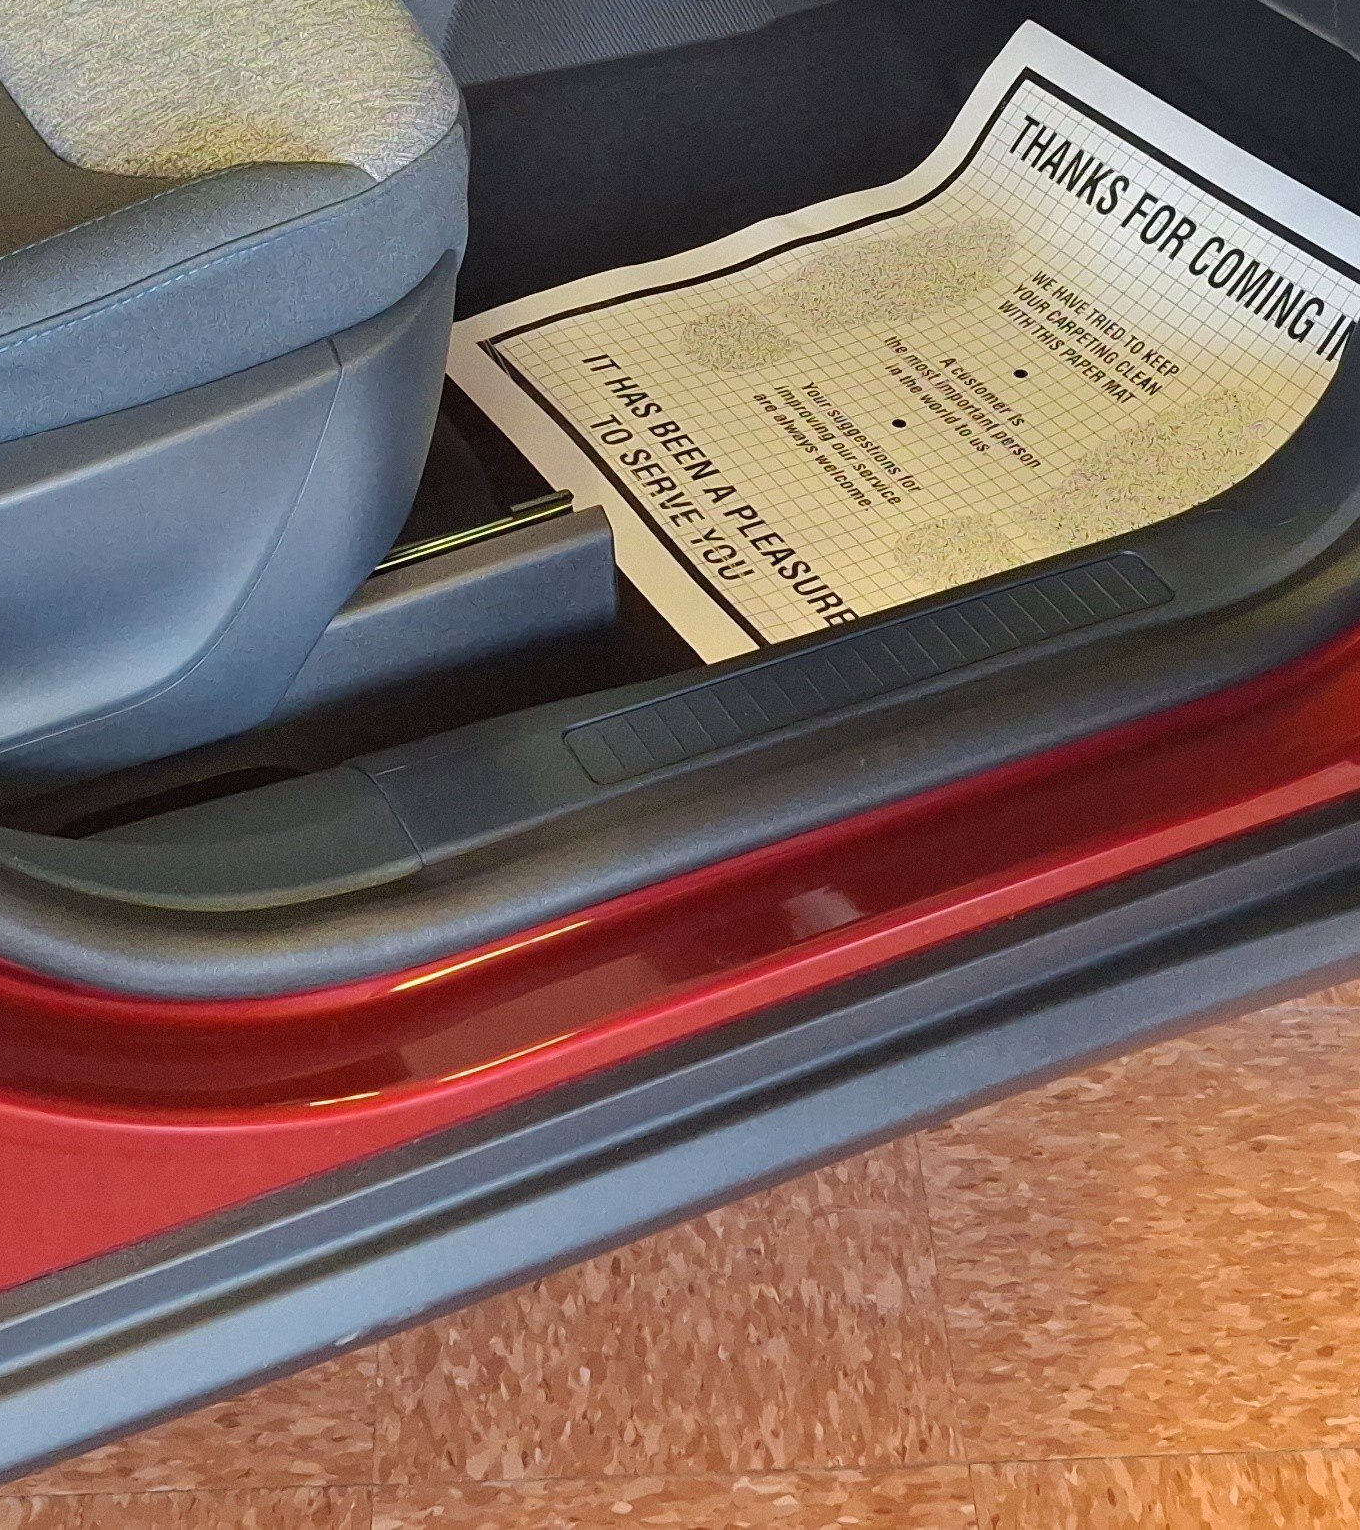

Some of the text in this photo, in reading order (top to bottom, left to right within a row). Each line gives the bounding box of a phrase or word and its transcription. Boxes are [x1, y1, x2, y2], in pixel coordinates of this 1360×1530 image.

[1009, 115, 1130, 215] THANKS
[1121, 192, 1197, 260] FOR
[1189, 236, 1325, 343] COMING
[998, 300, 1137, 403] WITH THIS PAPER MAT
[1013, 283, 1163, 396] YOUR CARPETING CLEAN
[1032, 271, 1180, 377] WE HAVE TRIED TO KEEP
[754, 393, 777, 412] are
[774, 414, 818, 453] always
[774, 385, 901, 505] improving our service
[802, 382, 922, 493] Your suggestions for
[884, 336, 1041, 469] the most important person
[885, 363, 989, 452] in the world to us
[939, 358, 1025, 427] A customer is
[582, 354, 859, 627] IT HAS BEEN A PLEASURE
[590, 415, 755, 581] TO SERVE YOU
